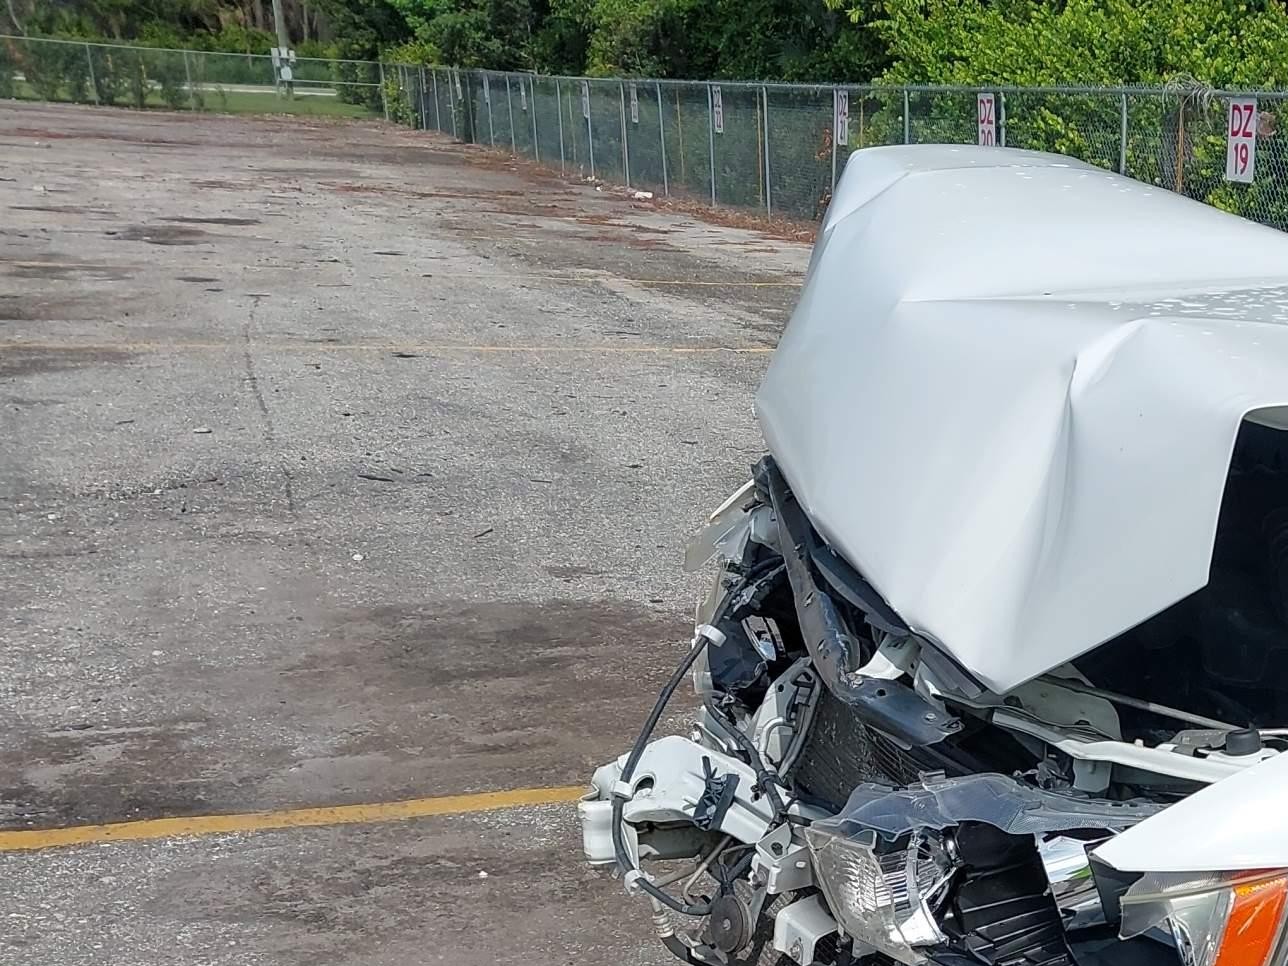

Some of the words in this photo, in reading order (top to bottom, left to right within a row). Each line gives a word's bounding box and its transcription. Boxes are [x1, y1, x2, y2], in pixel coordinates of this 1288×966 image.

[980, 99, 994, 125] DZ
[1231, 104, 1254, 137] DZ
[1233, 142, 1249, 175] 19
